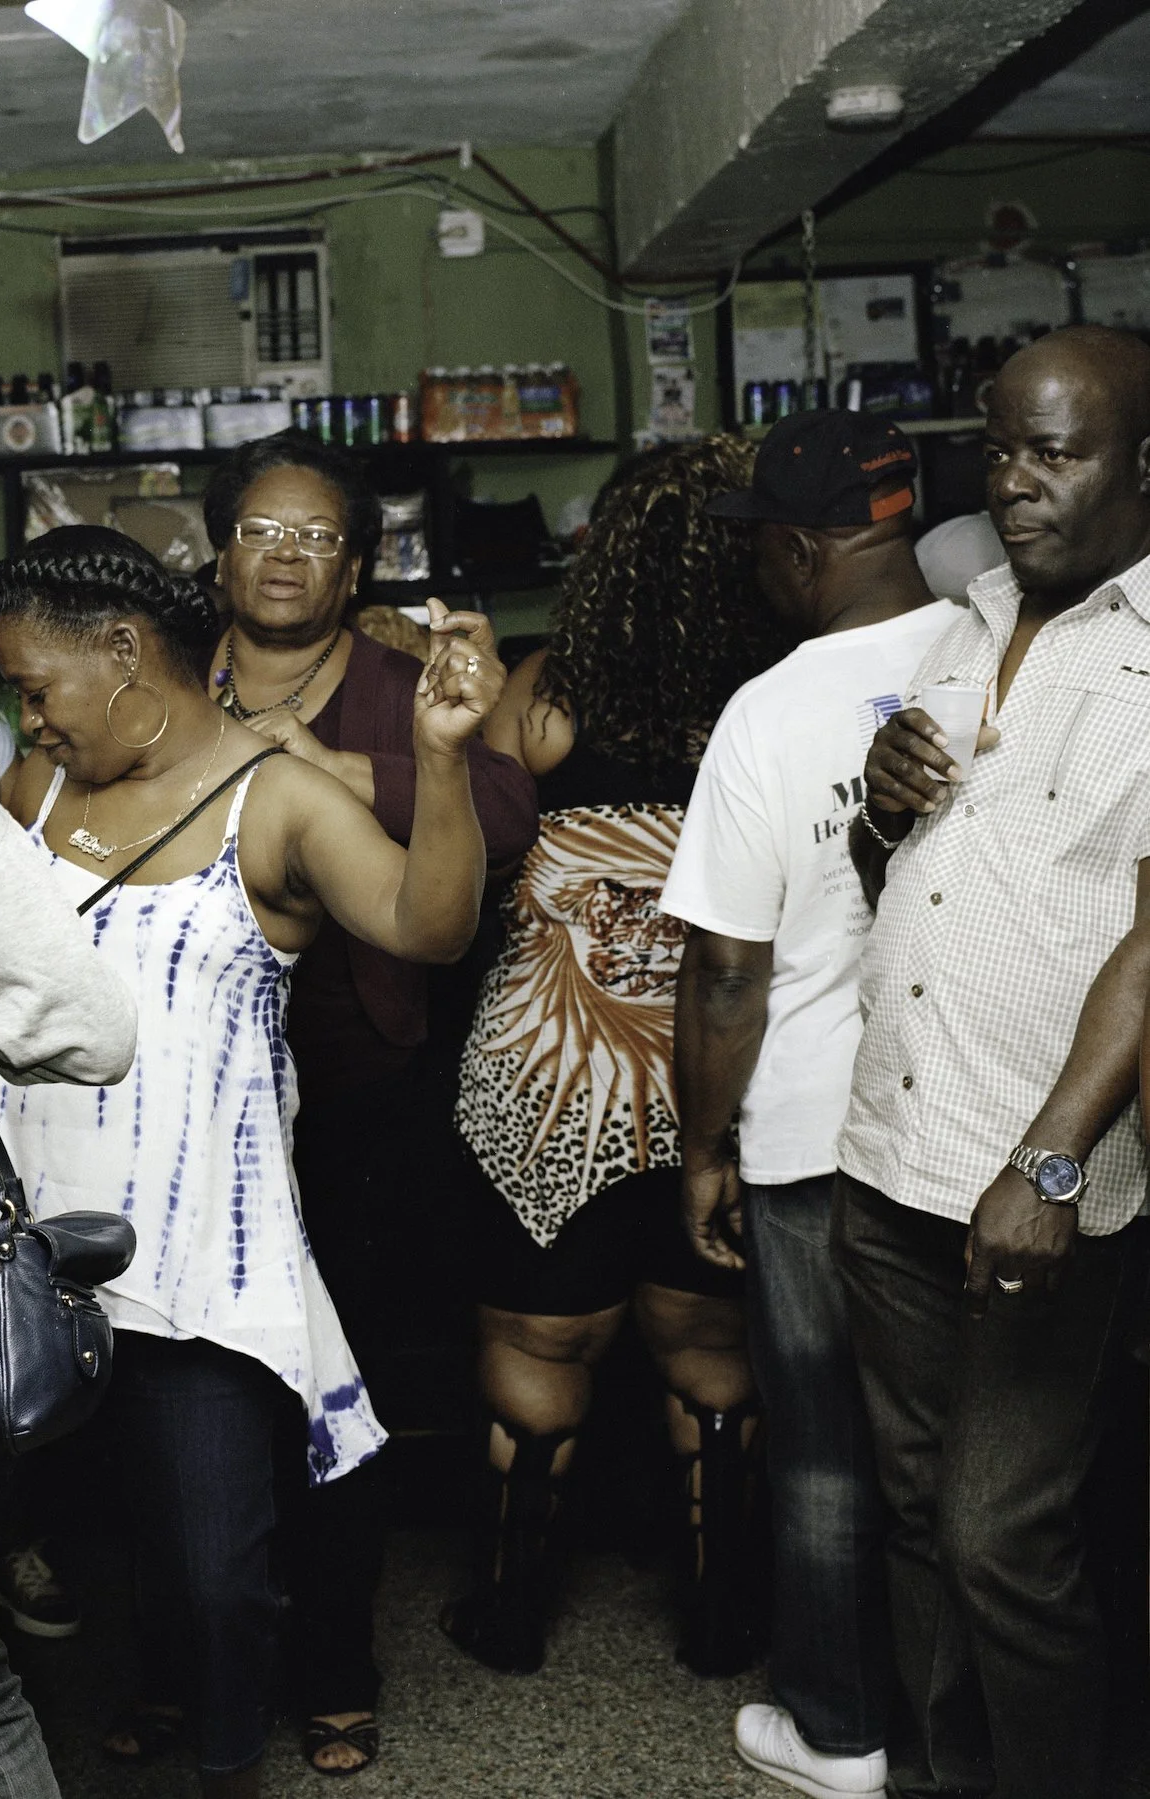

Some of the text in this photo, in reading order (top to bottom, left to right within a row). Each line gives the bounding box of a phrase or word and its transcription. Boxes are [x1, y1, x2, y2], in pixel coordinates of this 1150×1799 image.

[830, 775, 864, 812] M
[813, 818, 852, 844] He
[822, 864, 855, 882] MEMO
[823, 882, 842, 897] JOE
